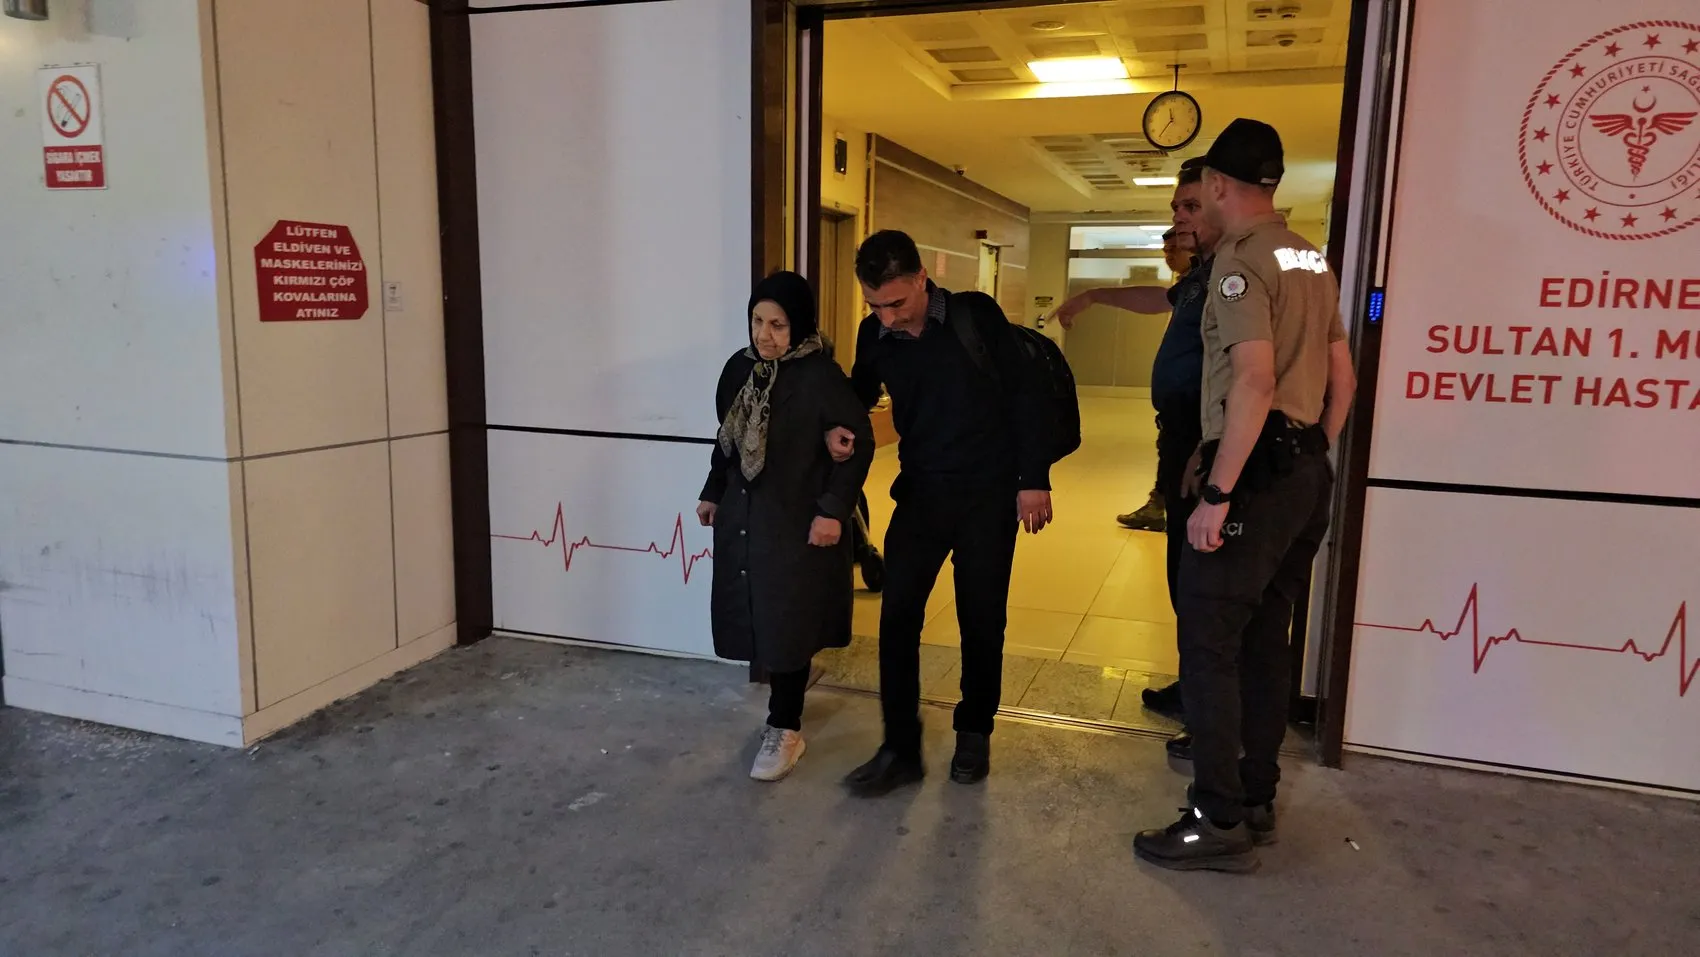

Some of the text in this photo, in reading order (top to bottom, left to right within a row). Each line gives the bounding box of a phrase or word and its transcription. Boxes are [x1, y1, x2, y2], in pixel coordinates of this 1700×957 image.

[1566, 61, 1664, 129] CUMHURİYETİ
[1563, 135, 1599, 192] TÜRKİYE
[286, 225, 337, 238] LÜTFEN
[273, 241, 351, 255] ELDİVEN VE
[260, 258, 362, 271] MASKELERİNİZİ
[273, 275, 355, 288] KIRMIZI ÇÖP
[273, 292, 357, 302] KOVALARINA
[1539, 270, 1700, 310] EDİRNE
[296, 308, 339, 318] ATINIZ
[1425, 325, 1700, 360] SULTAN 1. M
[1405, 371, 1562, 405] DEVLET
